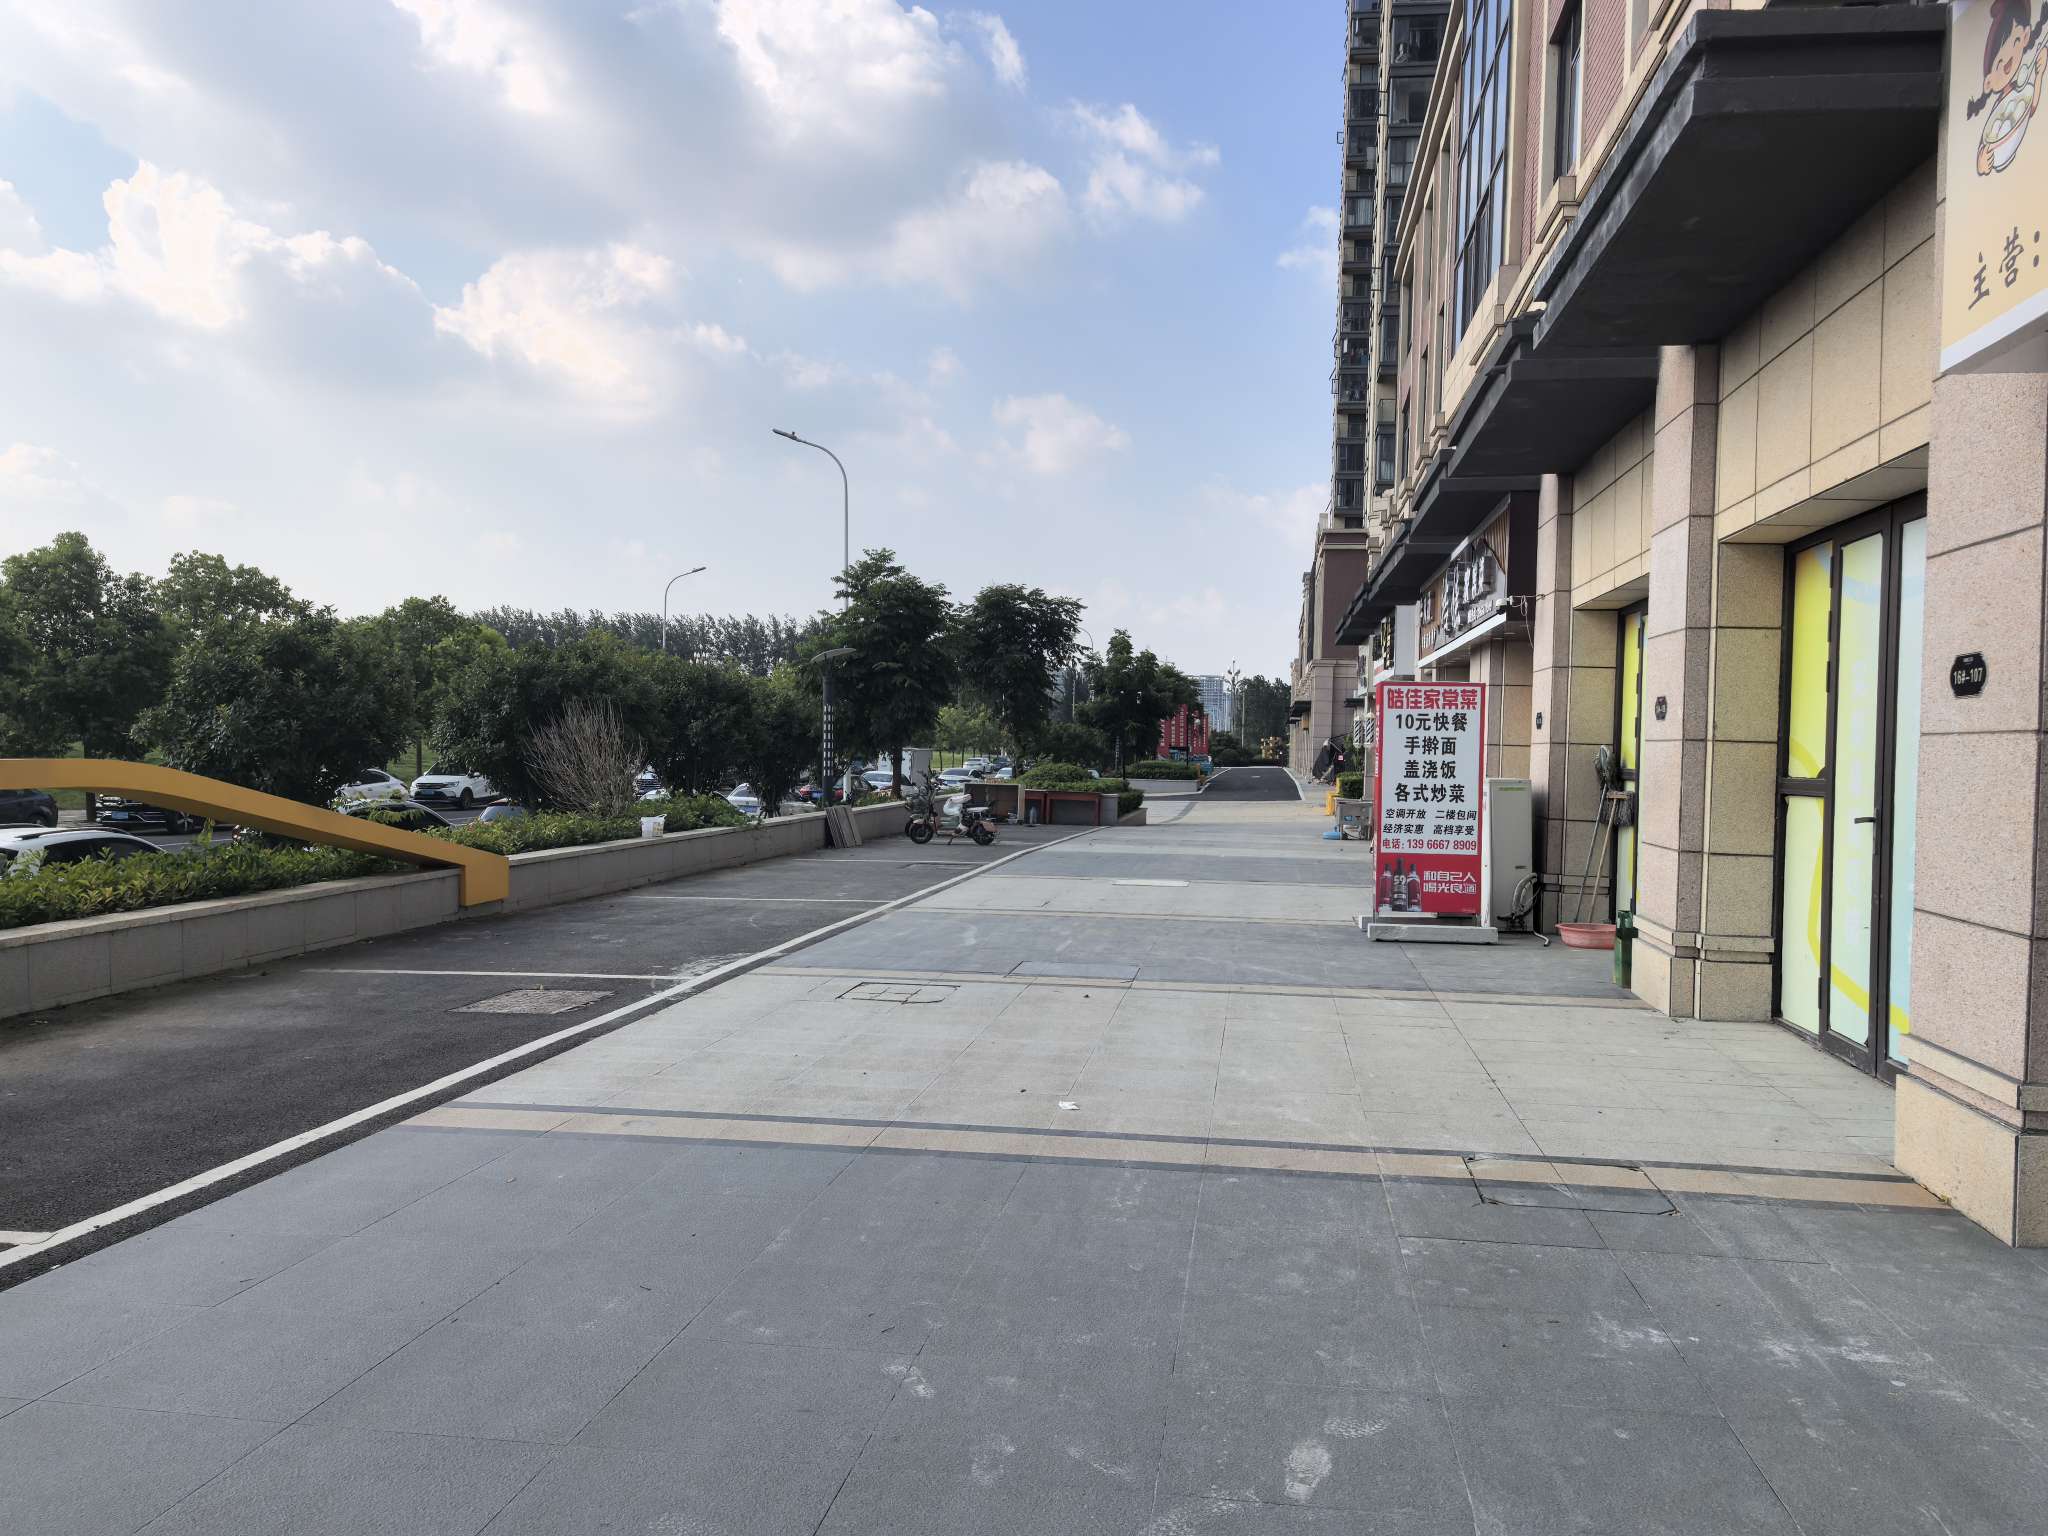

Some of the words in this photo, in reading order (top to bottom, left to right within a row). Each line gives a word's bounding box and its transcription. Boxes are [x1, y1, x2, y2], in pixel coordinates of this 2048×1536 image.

[1395, 712, 1468, 732] 10元快餐
[1404, 736, 1457, 756] 手擀面
[1403, 760, 1457, 779] 盖浇饭
[1395, 782, 1465, 803] 各式炒菜
[1385, 808, 1427, 819] 空调开放
[1434, 809, 1478, 821] 二楼包间
[1382, 823, 1425, 835] 经济实惠
[1432, 824, 1475, 836] 高档享受
